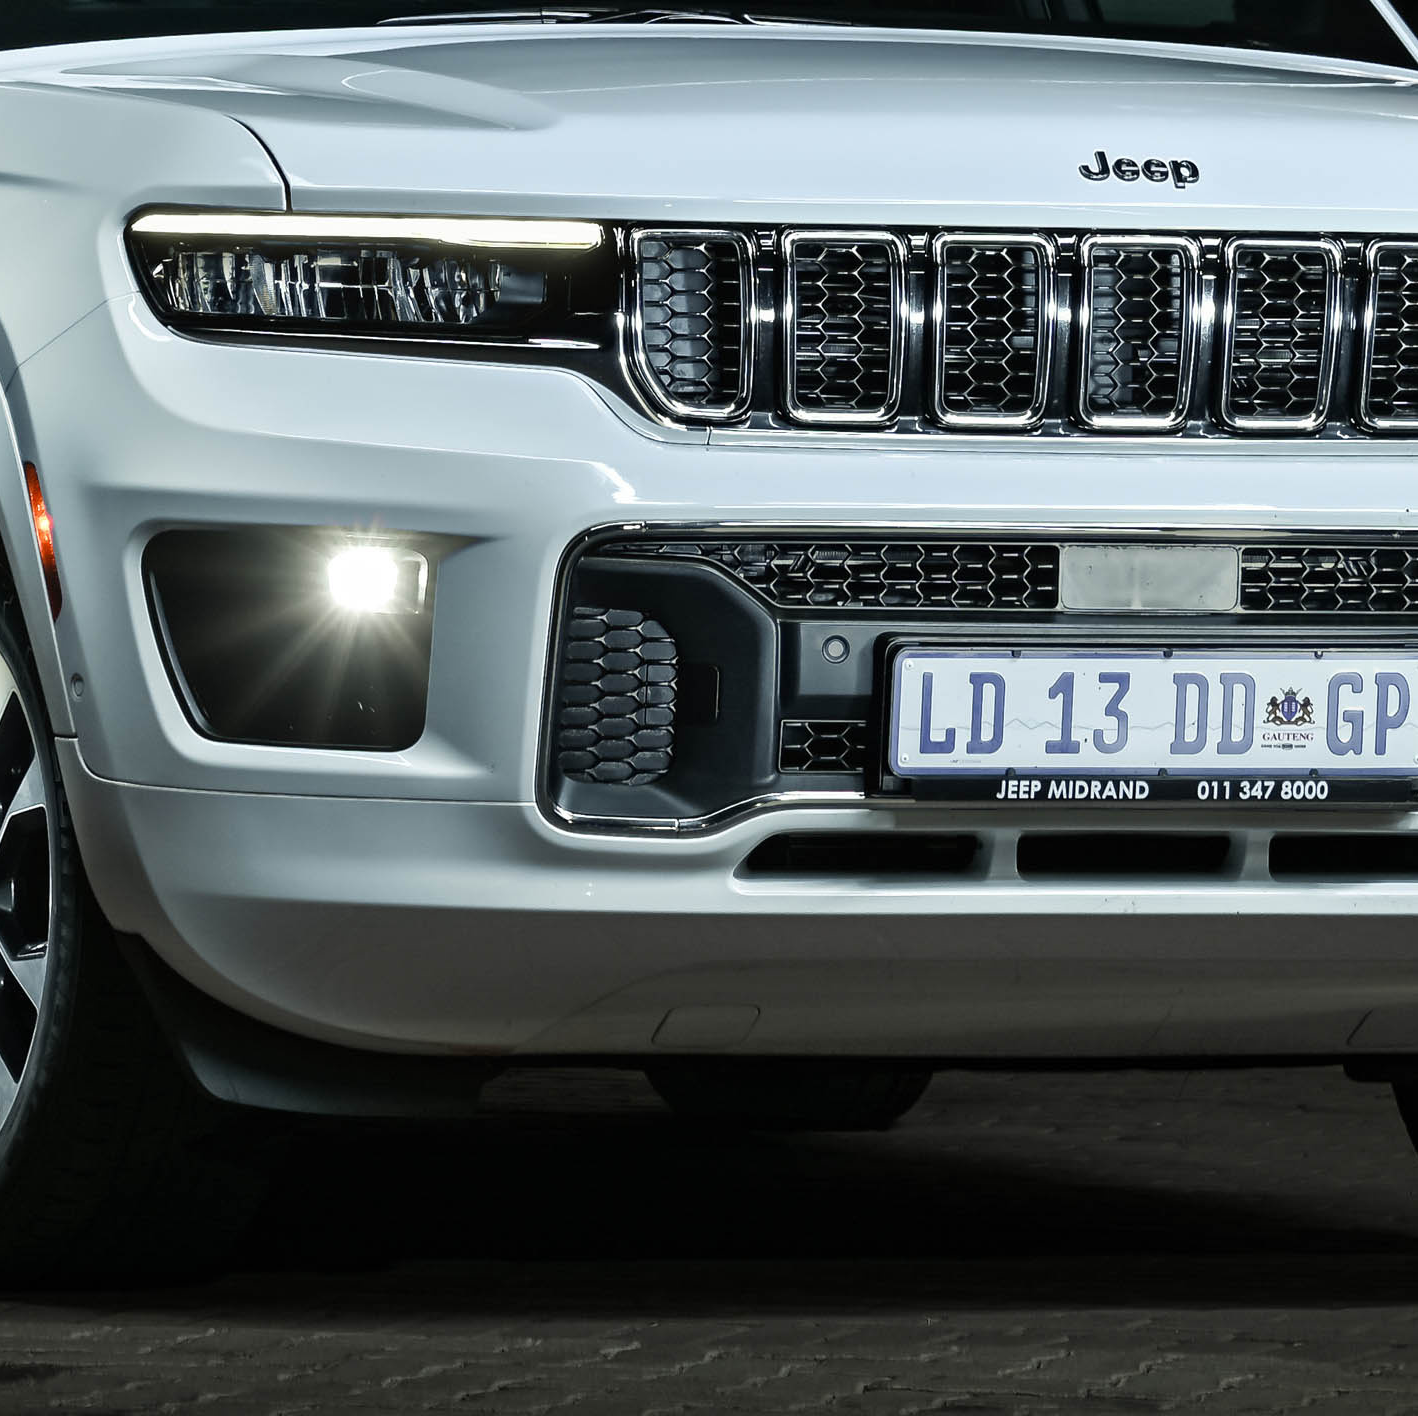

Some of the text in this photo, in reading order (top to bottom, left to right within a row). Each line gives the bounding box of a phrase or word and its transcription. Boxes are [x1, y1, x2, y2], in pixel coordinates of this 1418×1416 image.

[1078, 151, 1199, 189] Jeep
[919, 671, 1411, 757] LD 13 DD GP
[1262, 732, 1315, 742] GAUTENG
[996, 780, 1329, 801] JEEP MIDRAND 011 347 8000
